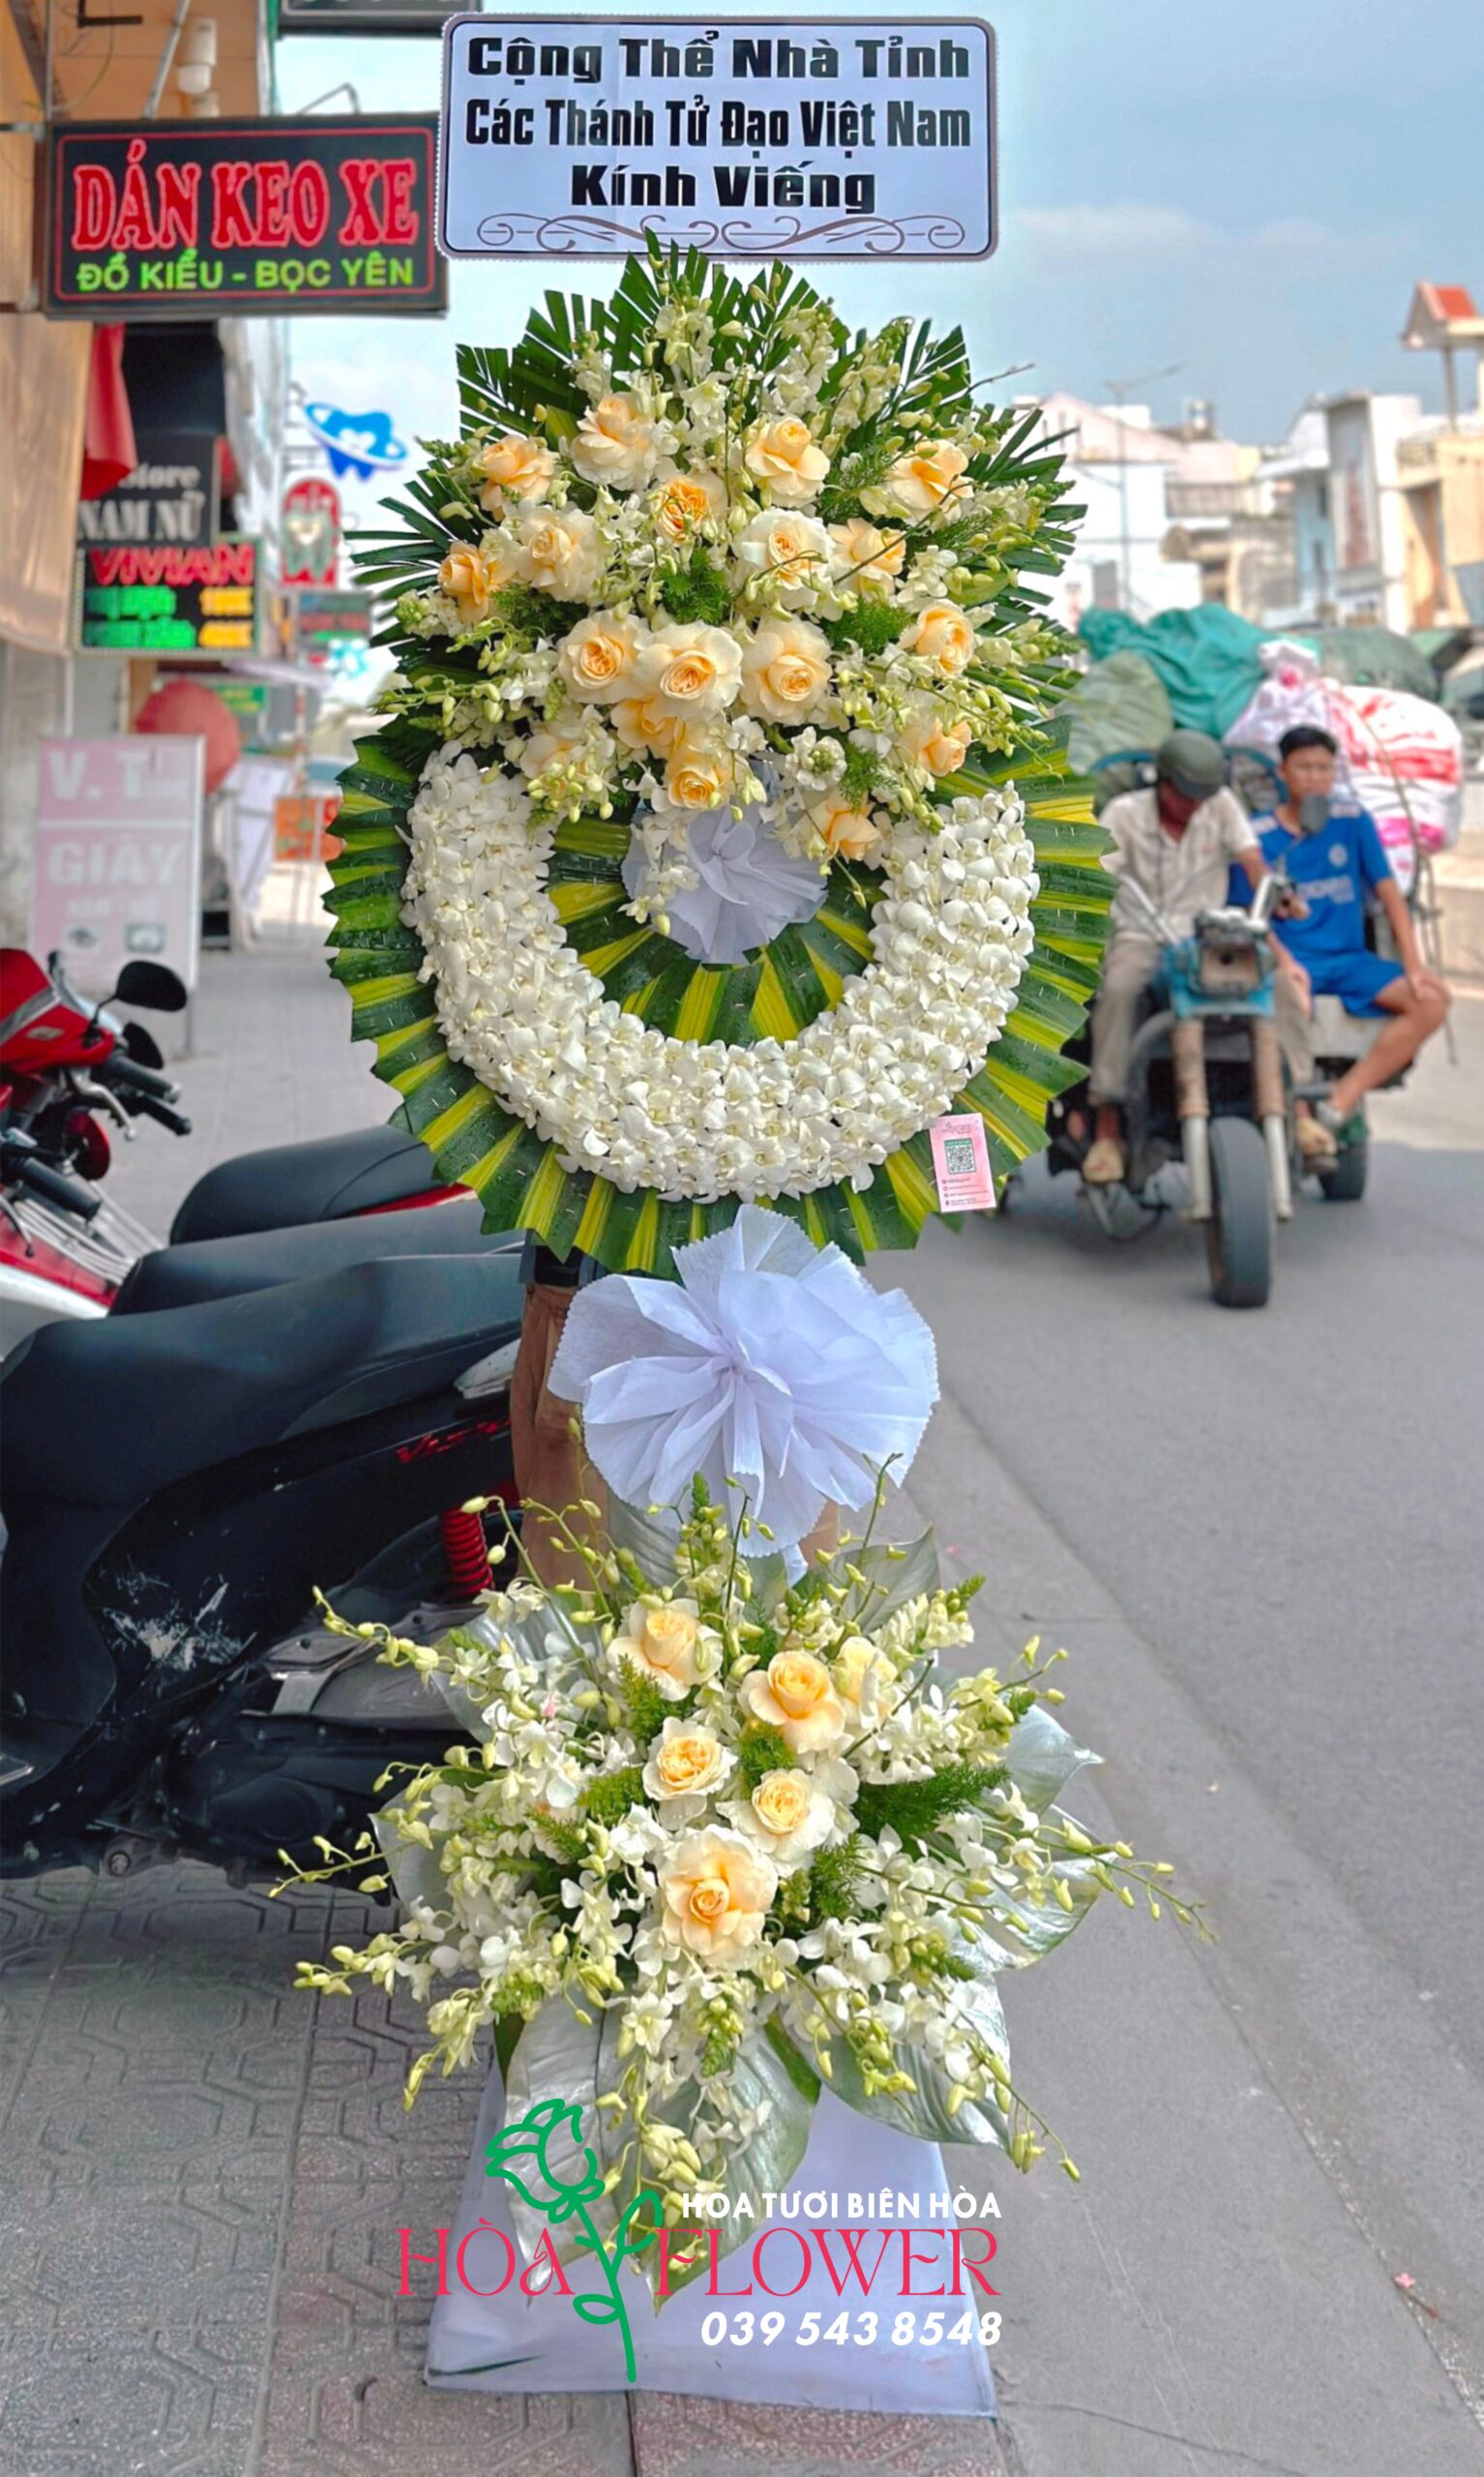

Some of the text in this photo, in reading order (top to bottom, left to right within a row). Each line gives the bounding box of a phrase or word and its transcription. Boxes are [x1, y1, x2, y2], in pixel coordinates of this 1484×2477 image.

[467, 30, 969, 86] Cộng Thể Nhà Tỉnh
[464, 94, 971, 158] Các Thánh Tử Đạo Việt Nam
[72, 138, 420, 251] DÁN KEO XE
[571, 161, 876, 215] Kính Viếng
[255, 260, 331, 293] BỌC
[341, 252, 413, 286] YÊN
